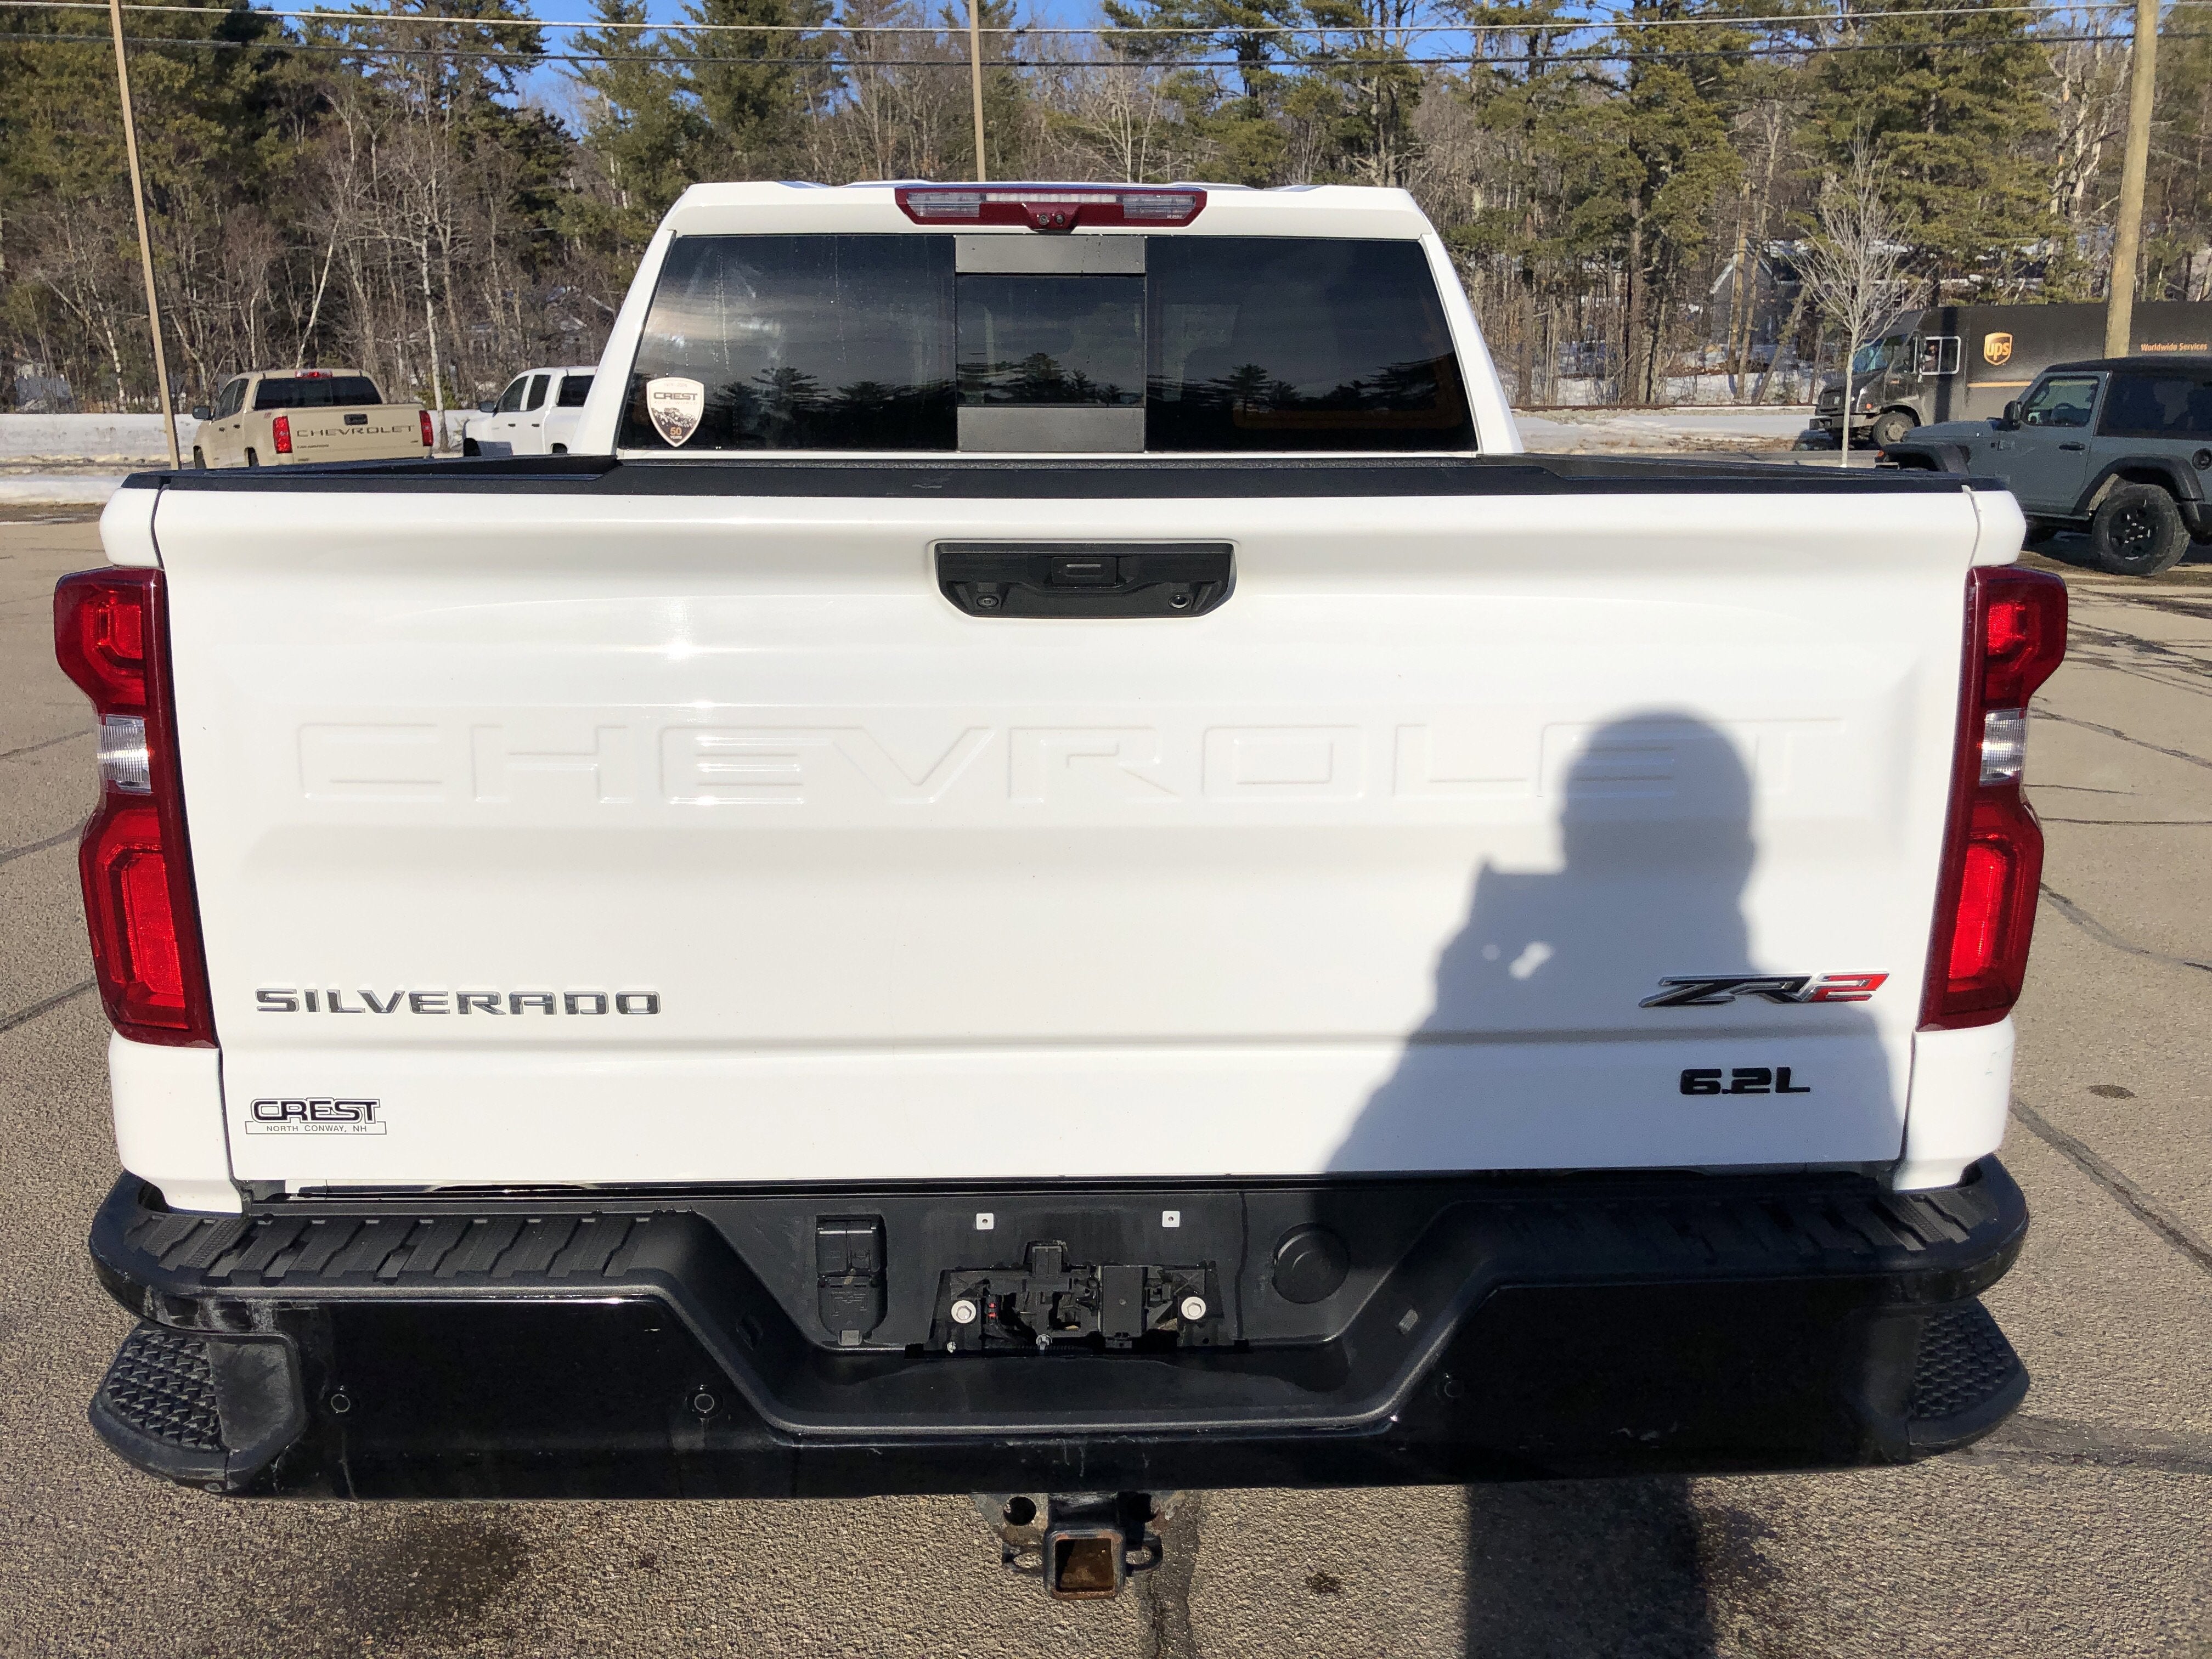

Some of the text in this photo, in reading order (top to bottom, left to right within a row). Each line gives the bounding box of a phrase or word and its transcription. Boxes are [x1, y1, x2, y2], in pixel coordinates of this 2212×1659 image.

[1986, 341, 2010, 361] ups
[2141, 342, 2208, 352] Worldwide Services
[653, 392, 698, 401] CREST
[297, 425, 413, 438] CHEVROLET
[670, 427, 682, 436] 50
[296, 718, 1847, 808] CHEVROLET
[1639, 970, 1891, 1008] ZR2
[255, 988, 662, 1015] SILVERADO
[1679, 1066, 1811, 1096] 6.2L
[251, 1098, 380, 1123] CREST
[304, 1125, 347, 1133] CONWAY,
